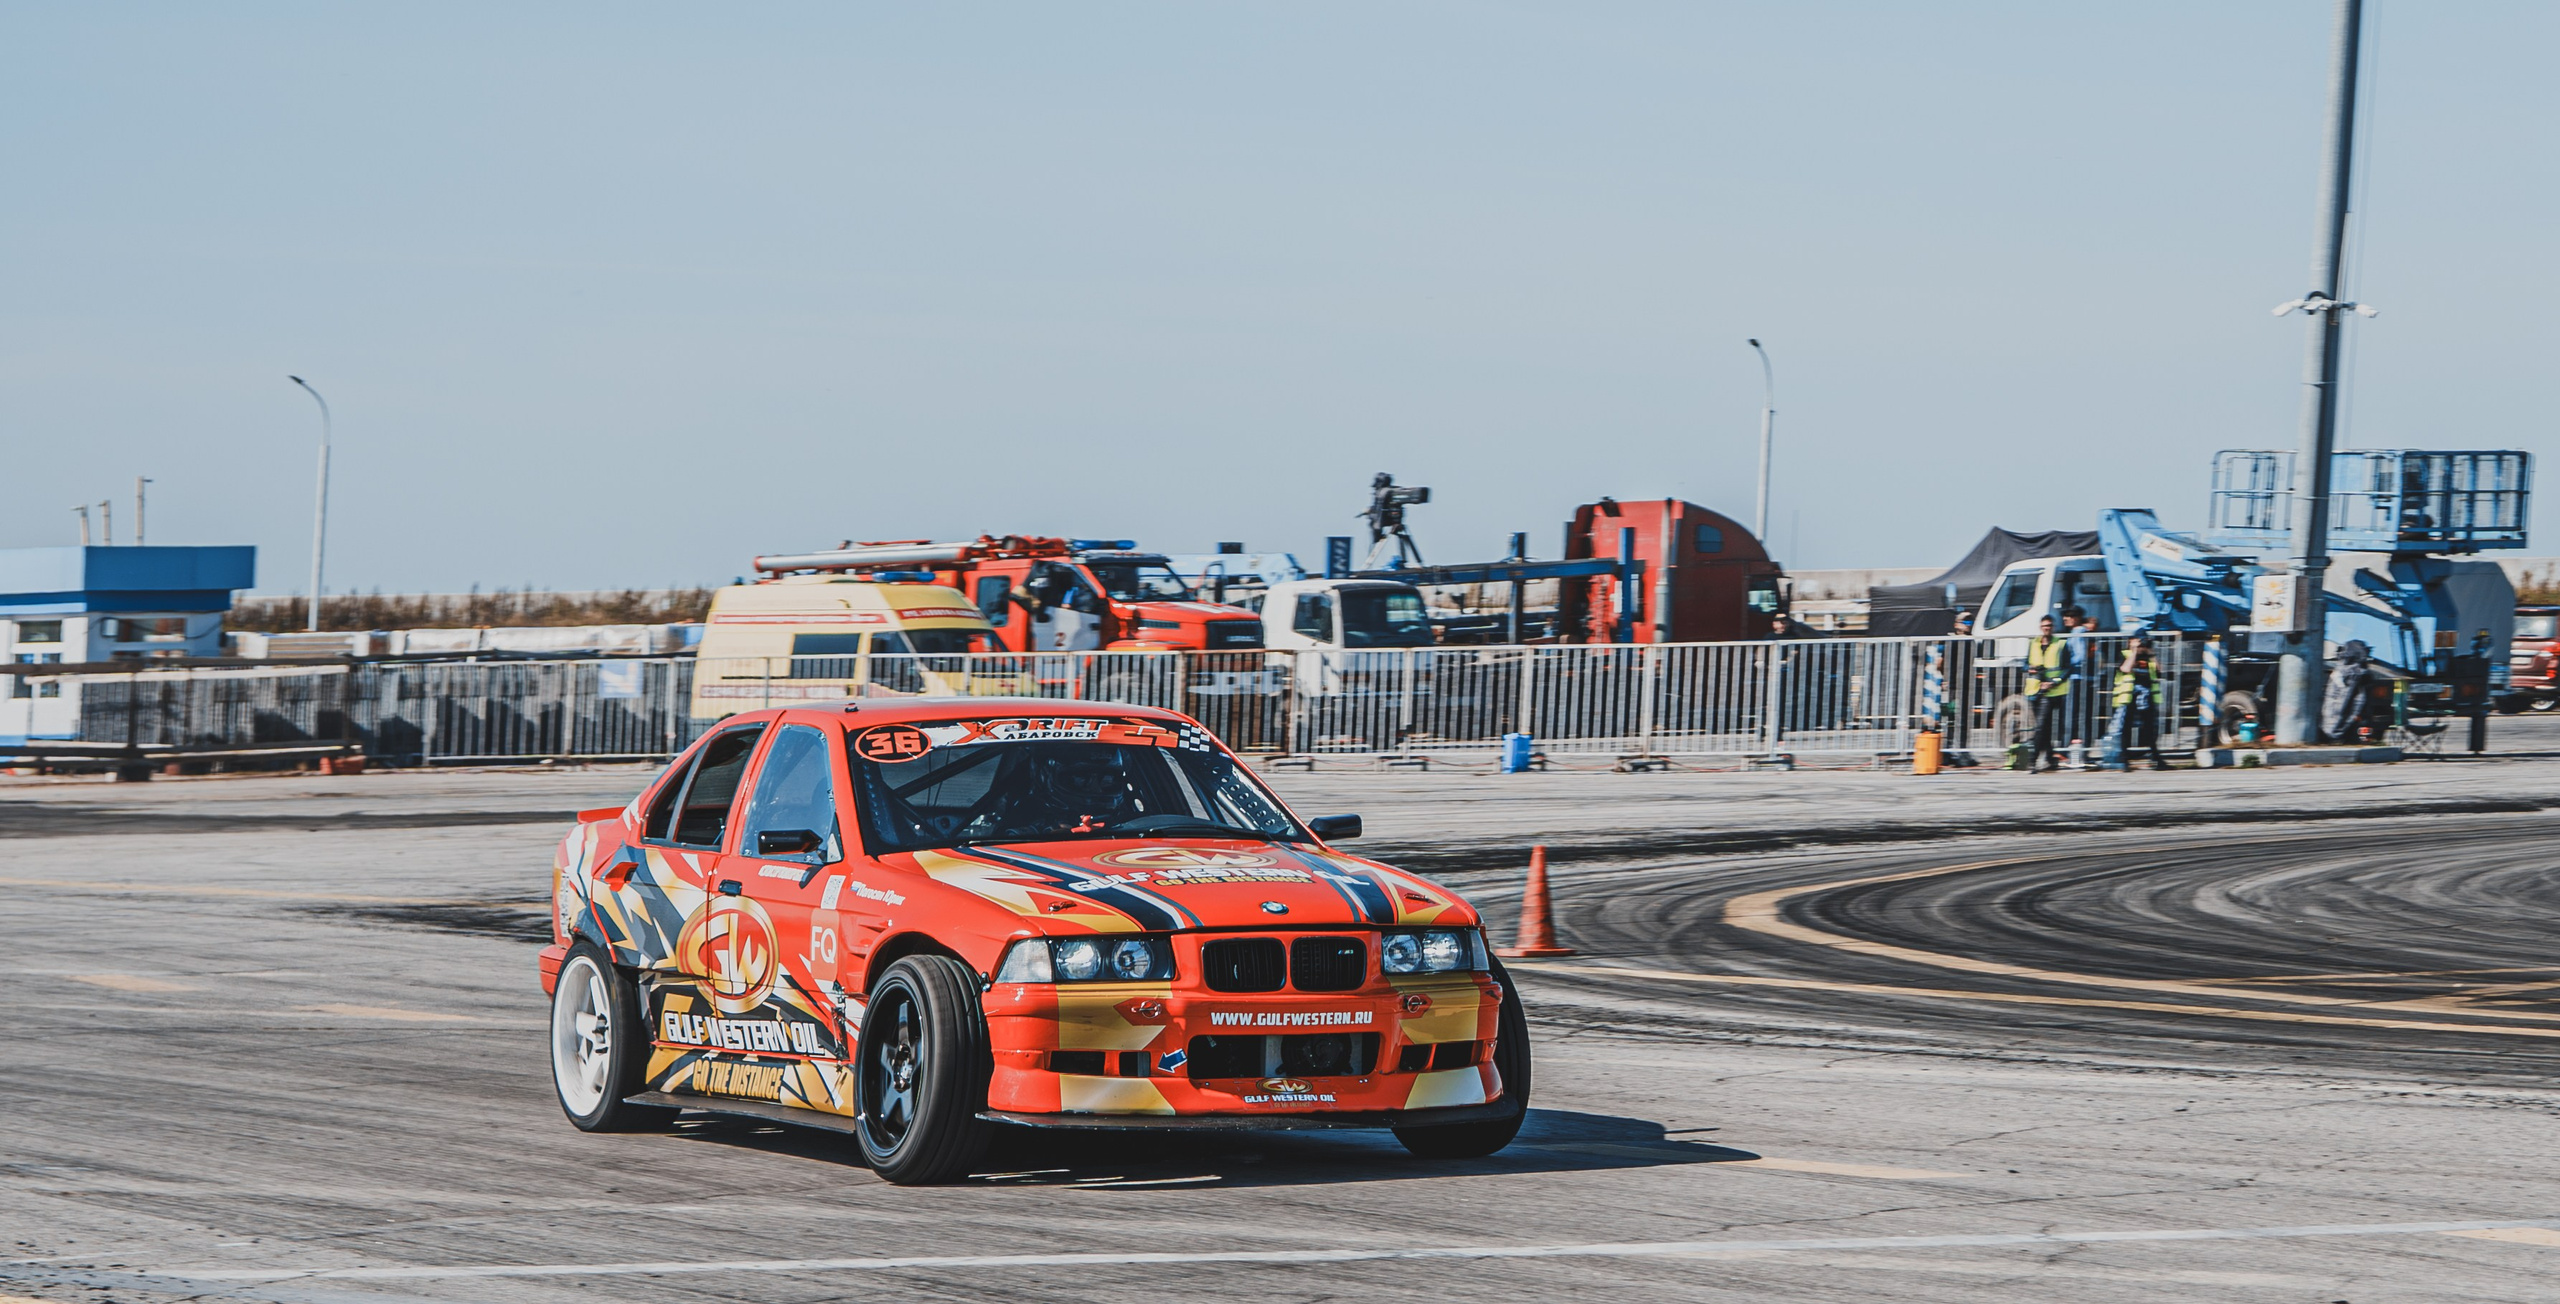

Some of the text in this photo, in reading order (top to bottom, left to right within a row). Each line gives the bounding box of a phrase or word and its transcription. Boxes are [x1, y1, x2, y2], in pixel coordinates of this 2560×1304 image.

[865, 731, 922, 756] 36
[1068, 868, 1370, 892] GULF WESTERN OIL
[1154, 875, 1315, 886] GO THE DISTANCE
[811, 926, 837, 963] FQ
[1211, 1011, 1373, 1026] WWW.GULFWESTERN.RU
[664, 1012, 825, 1055] GULF WESTERN OIL
[692, 1059, 784, 1100] GO THE DISTANCE
[1244, 1094, 1337, 1103] GULF WESTERN OIL
